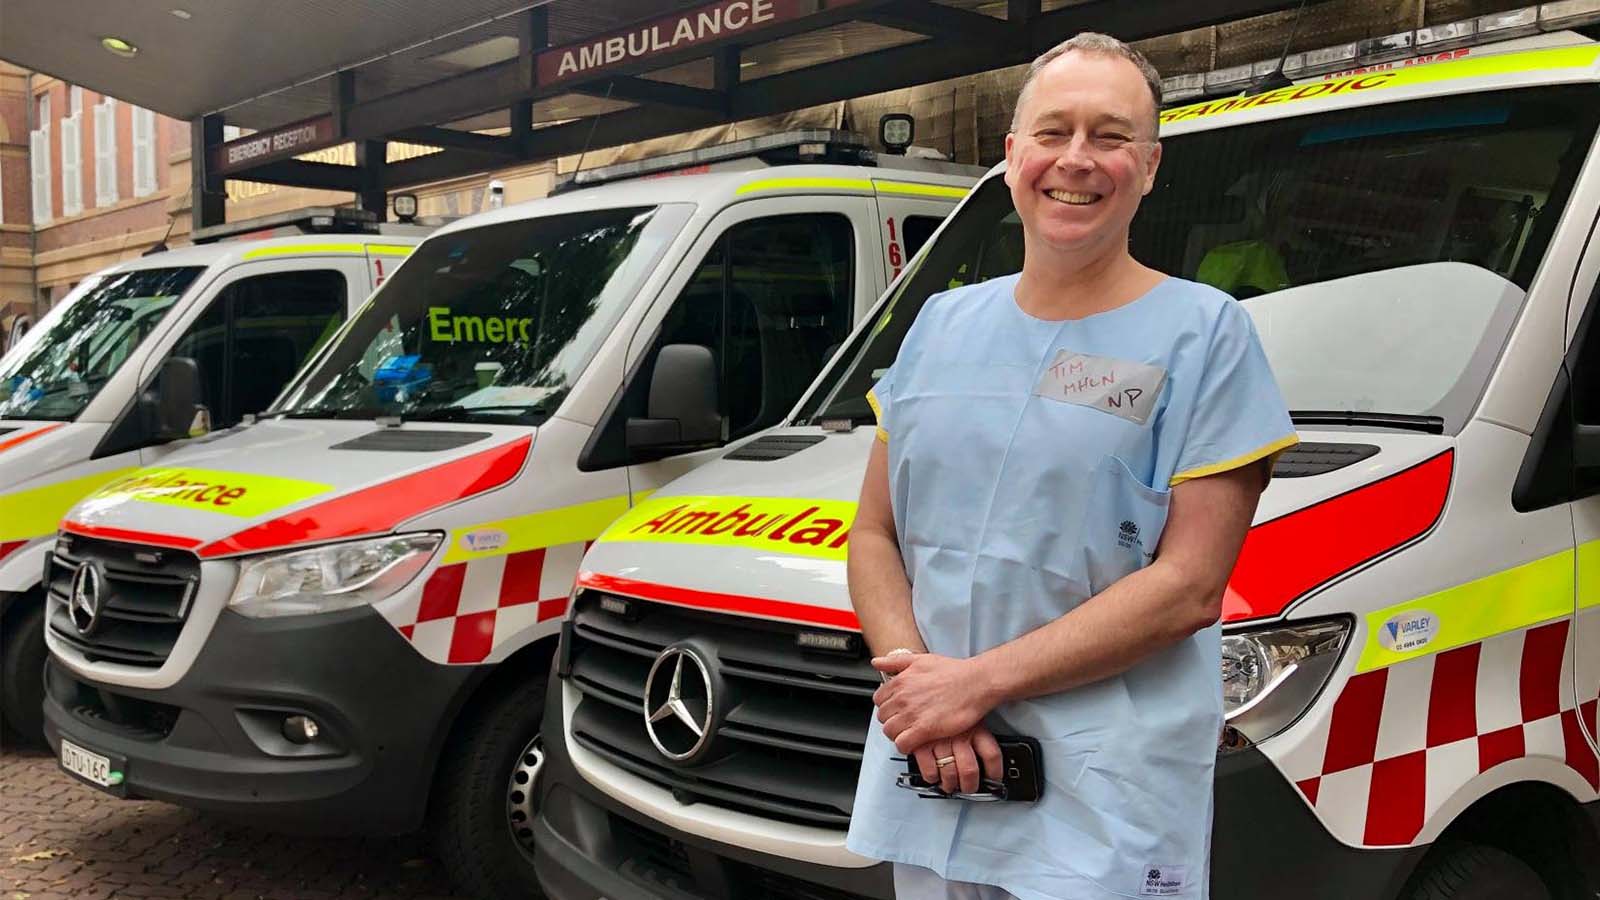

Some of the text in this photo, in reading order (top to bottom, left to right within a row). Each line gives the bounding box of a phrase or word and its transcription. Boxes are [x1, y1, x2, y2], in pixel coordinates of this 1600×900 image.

[557, 0, 776, 77] AMBULANCE
[1159, 73, 1396, 122] RAMEDIC
[228, 126, 317, 164] EMERGENCY RECEPTION
[1048, 361, 1083, 379] TIM
[1107, 388, 1143, 408] NP
